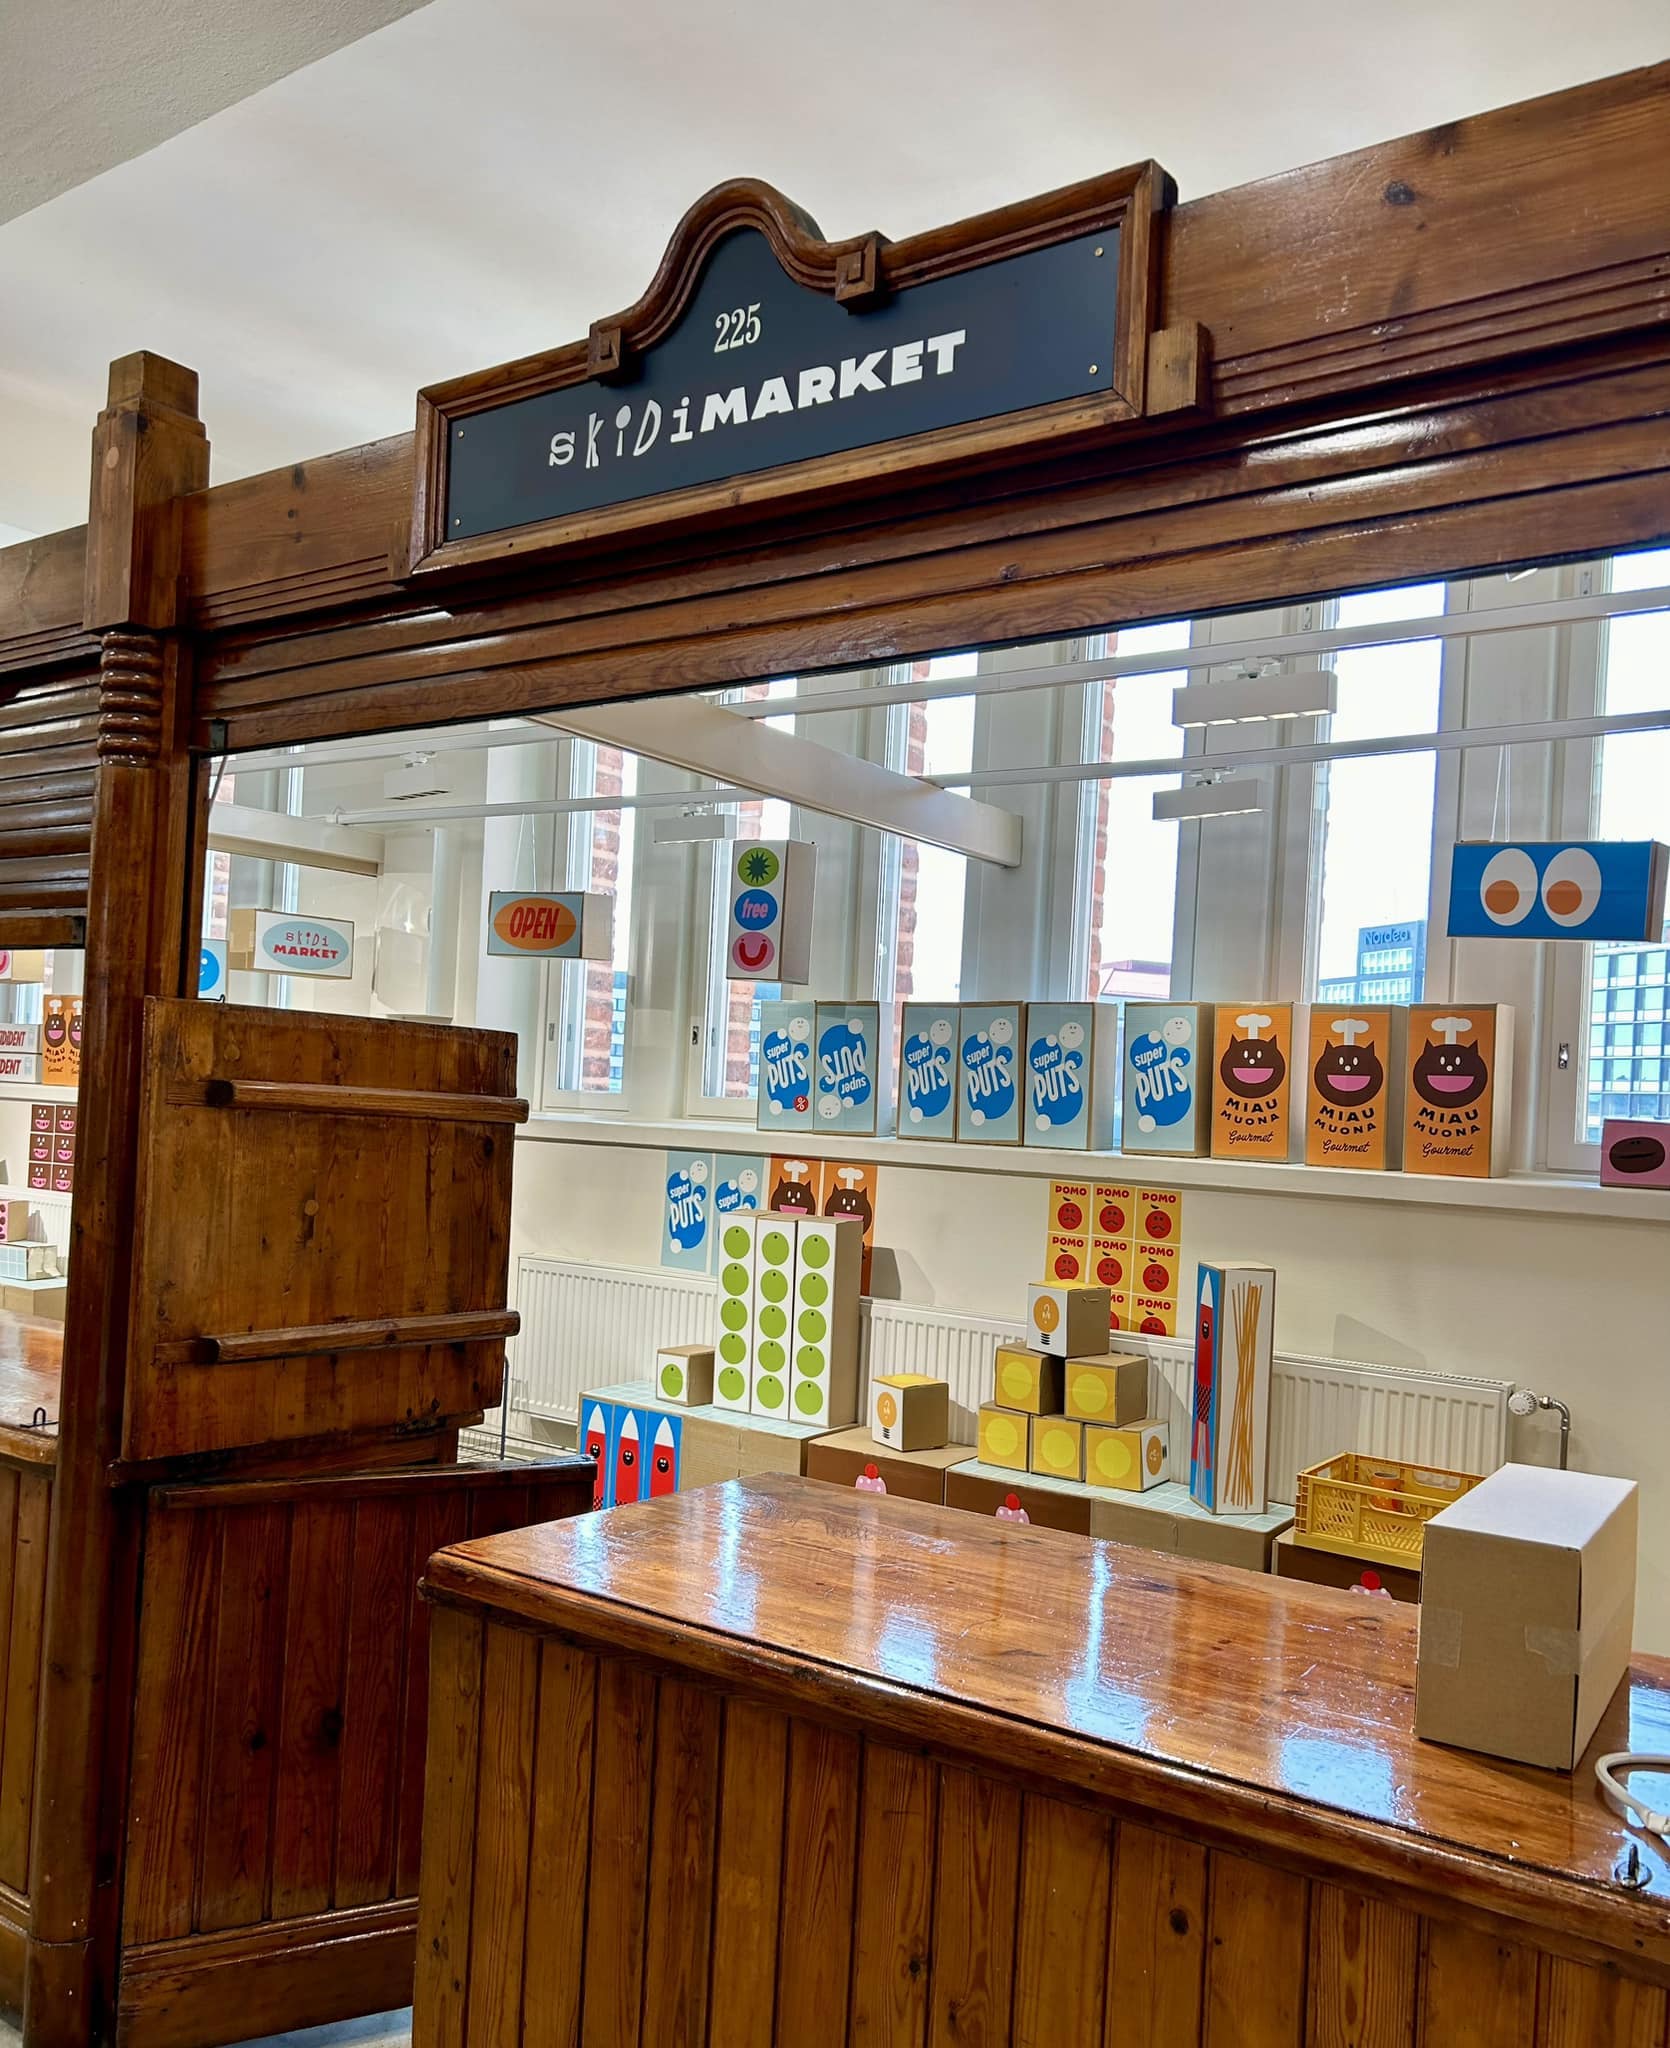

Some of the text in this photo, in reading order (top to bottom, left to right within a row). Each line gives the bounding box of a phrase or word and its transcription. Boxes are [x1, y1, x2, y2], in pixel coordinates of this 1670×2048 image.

[713, 302, 761, 353] 225
[742, 898, 769, 919] free
[509, 906, 560, 939] OPEN
[1364, 928, 1411, 945] Nordea
[273, 944, 339, 960] MARKET
[766, 1041, 789, 1059] super
[907, 1045, 930, 1064] super
[966, 1045, 990, 1065] super
[1033, 1049, 1059, 1069] super
[1134, 1046, 1164, 1066] super
[767, 1050, 807, 1094] PUTS
[821, 1041, 866, 1085] PUTS
[840, 1076, 867, 1094] super
[908, 1055, 948, 1100] PUTS
[967, 1055, 1011, 1103] PUTS
[1033, 1059, 1080, 1107] PUTS
[1135, 1056, 1188, 1107] PUTS
[1225, 1097, 1278, 1113] MIAU
[1319, 1105, 1375, 1122] MIAU
[1220, 1109, 1280, 1126] MUONA
[1418, 1106, 1479, 1124] MIAU
[1314, 1118, 1377, 1135] MUONA
[1413, 1120, 1481, 1138] MUONA
[1228, 1130, 1274, 1145] Gourmet
[1322, 1139, 1371, 1154] Gourmet
[1422, 1142, 1474, 1158] Gourmet
[670, 1183, 690, 1199] super
[1055, 1185, 1087, 1196] POMO
[1096, 1187, 1130, 1199] POMO
[1142, 1192, 1177, 1204] POMO
[670, 1193, 704, 1233] PUTS
[1052, 1236, 1084, 1248] POMO
[1094, 1239, 1127, 1251] POMO
[1139, 1245, 1174, 1257] POMO
[1137, 1298, 1171, 1310] POMO
